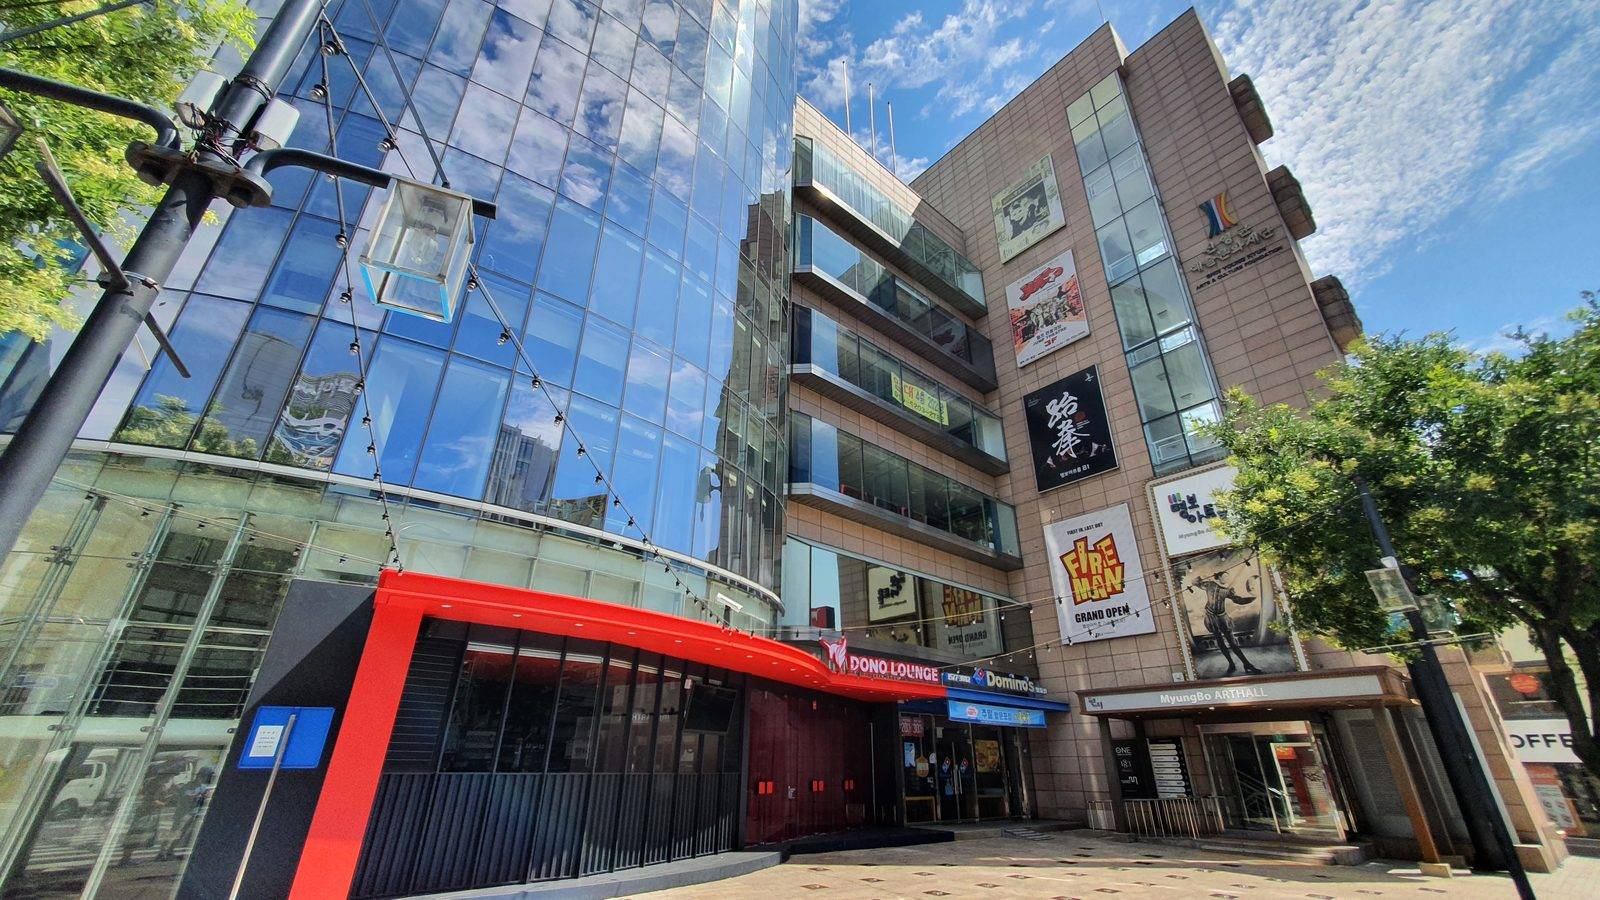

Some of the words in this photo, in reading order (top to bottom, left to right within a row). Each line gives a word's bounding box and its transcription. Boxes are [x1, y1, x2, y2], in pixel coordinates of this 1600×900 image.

[1044, 336, 1057, 347] 3F
[1062, 536, 1118, 579] FIRE
[1072, 565, 1123, 603] MAN
[1075, 609, 1104, 623] GRAND
[1105, 604, 1130, 618] OPEN
[850, 655, 887, 673] DONO
[890, 662, 939, 682] LOUNGE
[986, 670, 1034, 693] Domino's
[1160, 691, 1211, 704] MyungBo
[1214, 687, 1268, 700] ARTHALL
